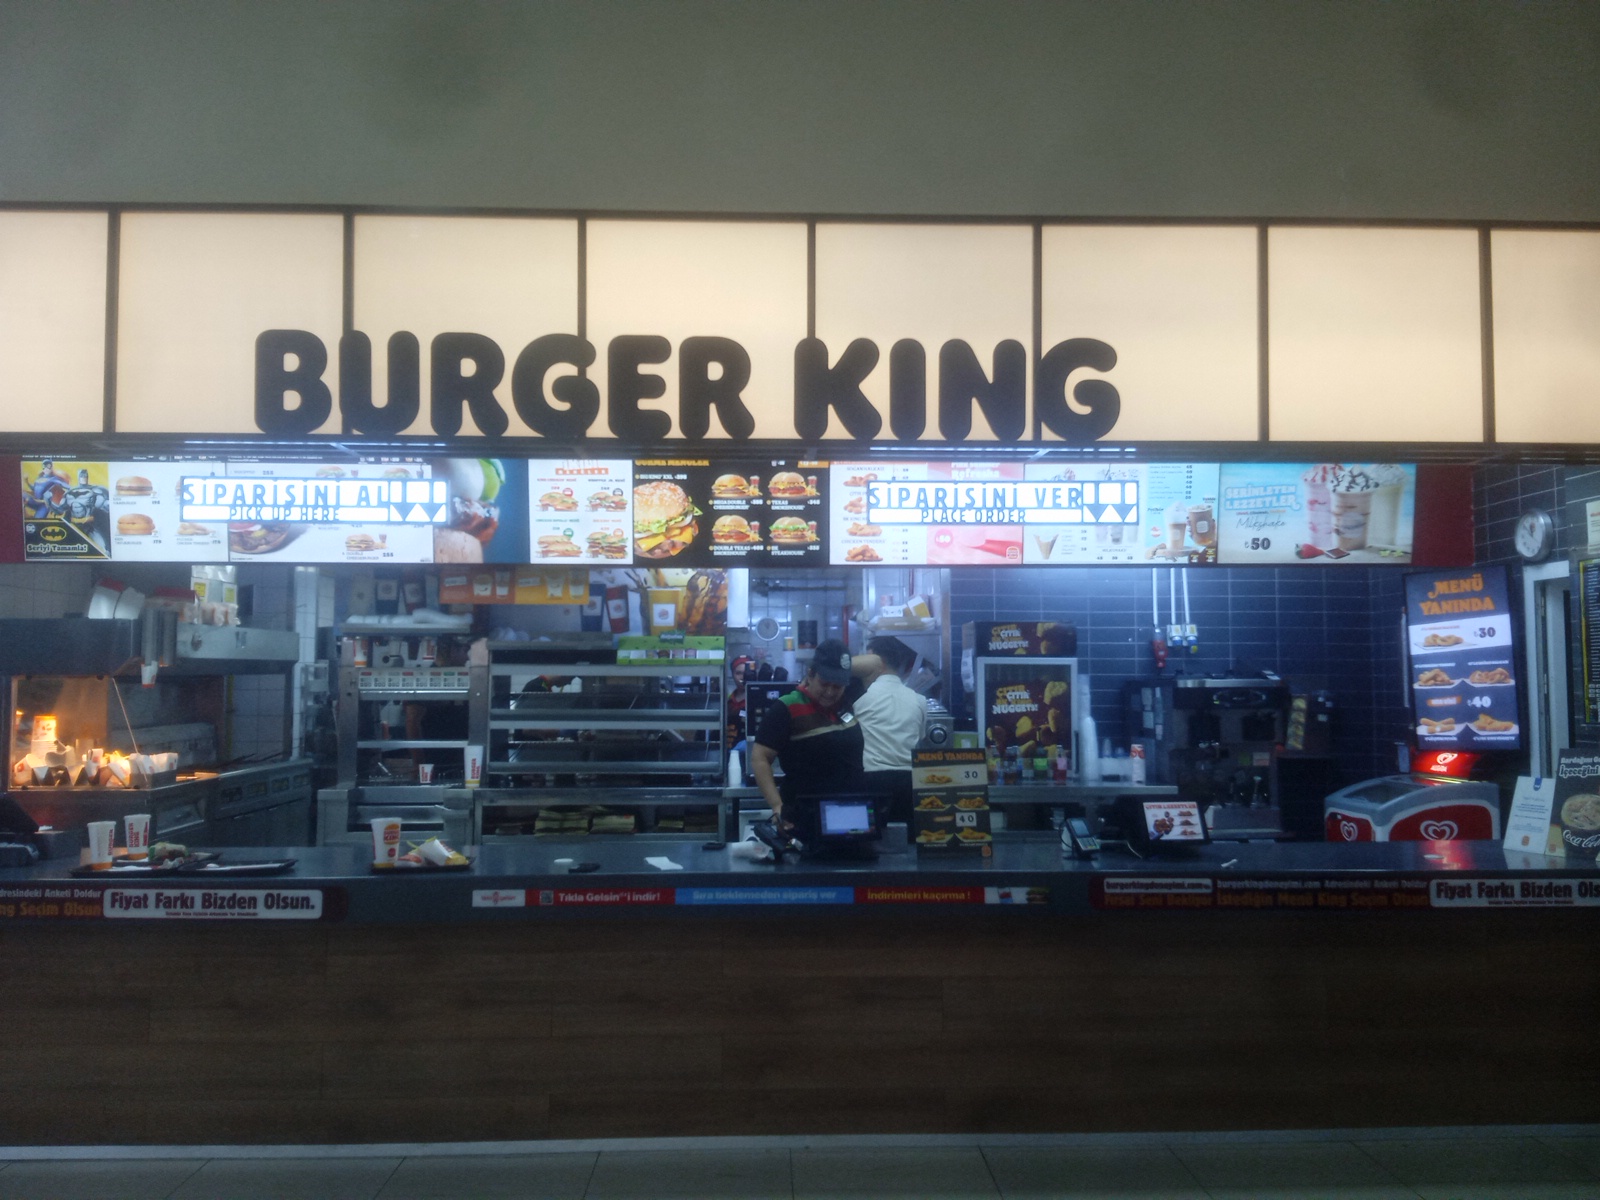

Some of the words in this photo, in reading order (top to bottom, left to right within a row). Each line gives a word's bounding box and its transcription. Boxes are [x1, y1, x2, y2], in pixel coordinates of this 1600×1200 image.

[254, 329, 754, 440] BURGER
[795, 336, 1121, 442] KING
[357, 484, 388, 507] AL
[1034, 487, 1082, 508] VER
[1225, 494, 1298, 510] LEZZETLER
[230, 506, 262, 521] PICK
[273, 506, 291, 521] UP
[300, 507, 340, 522] HERE
[921, 508, 967, 523] PLACE
[974, 509, 1026, 524] ORDER
[27, 543, 51, 554] Seriyi
[52, 544, 88, 553] Tamamla!
[1427, 573, 1484, 598] MENÜ
[1419, 596, 1496, 616] YANINDA
[992, 703, 1039, 714] NUGGETS!
[1558, 764, 1599, 778] İçeceğini
[44, 889, 71, 898] Anketi
[73, 889, 102, 898] Doldur
[558, 892, 583, 902] Tıkla
[1436, 882, 1472, 900] Fiyat
[1477, 882, 1515, 898] Farkı
[1520, 882, 1572, 898] Bizden
[110, 892, 149, 910] Fiyat
[155, 892, 195, 909] Farkı
[201, 892, 257, 909] Bizden
[264, 892, 315, 910] Olsun.
